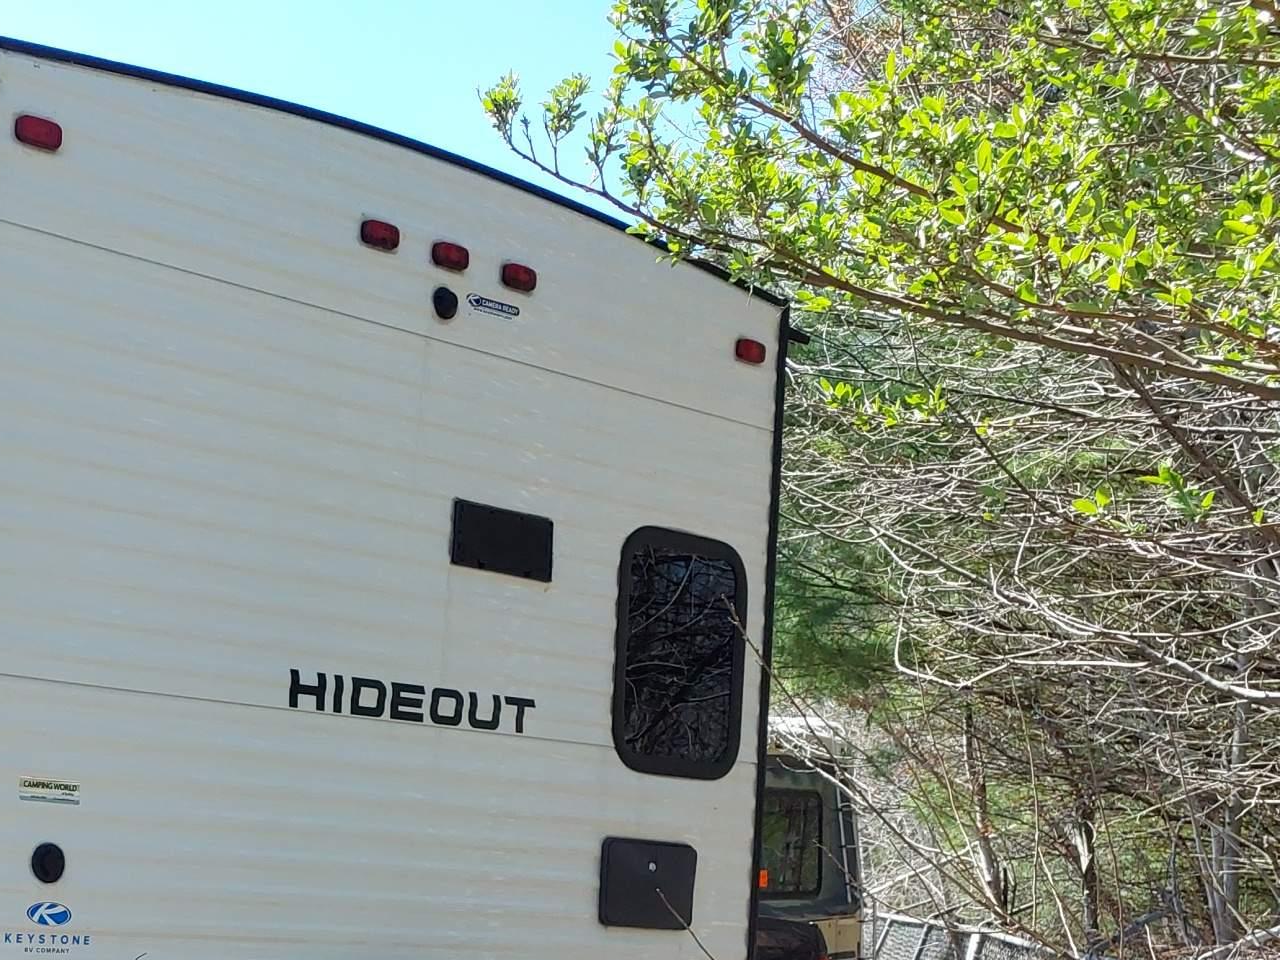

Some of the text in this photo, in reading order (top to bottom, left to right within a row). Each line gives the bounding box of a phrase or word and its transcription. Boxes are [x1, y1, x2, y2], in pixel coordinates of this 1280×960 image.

[481, 299, 502, 310] CAMERA
[288, 668, 537, 734] HIDEOUT
[23, 780, 78, 792] CAMPING WORLD
[4, 932, 90, 945] KEYSTONE
